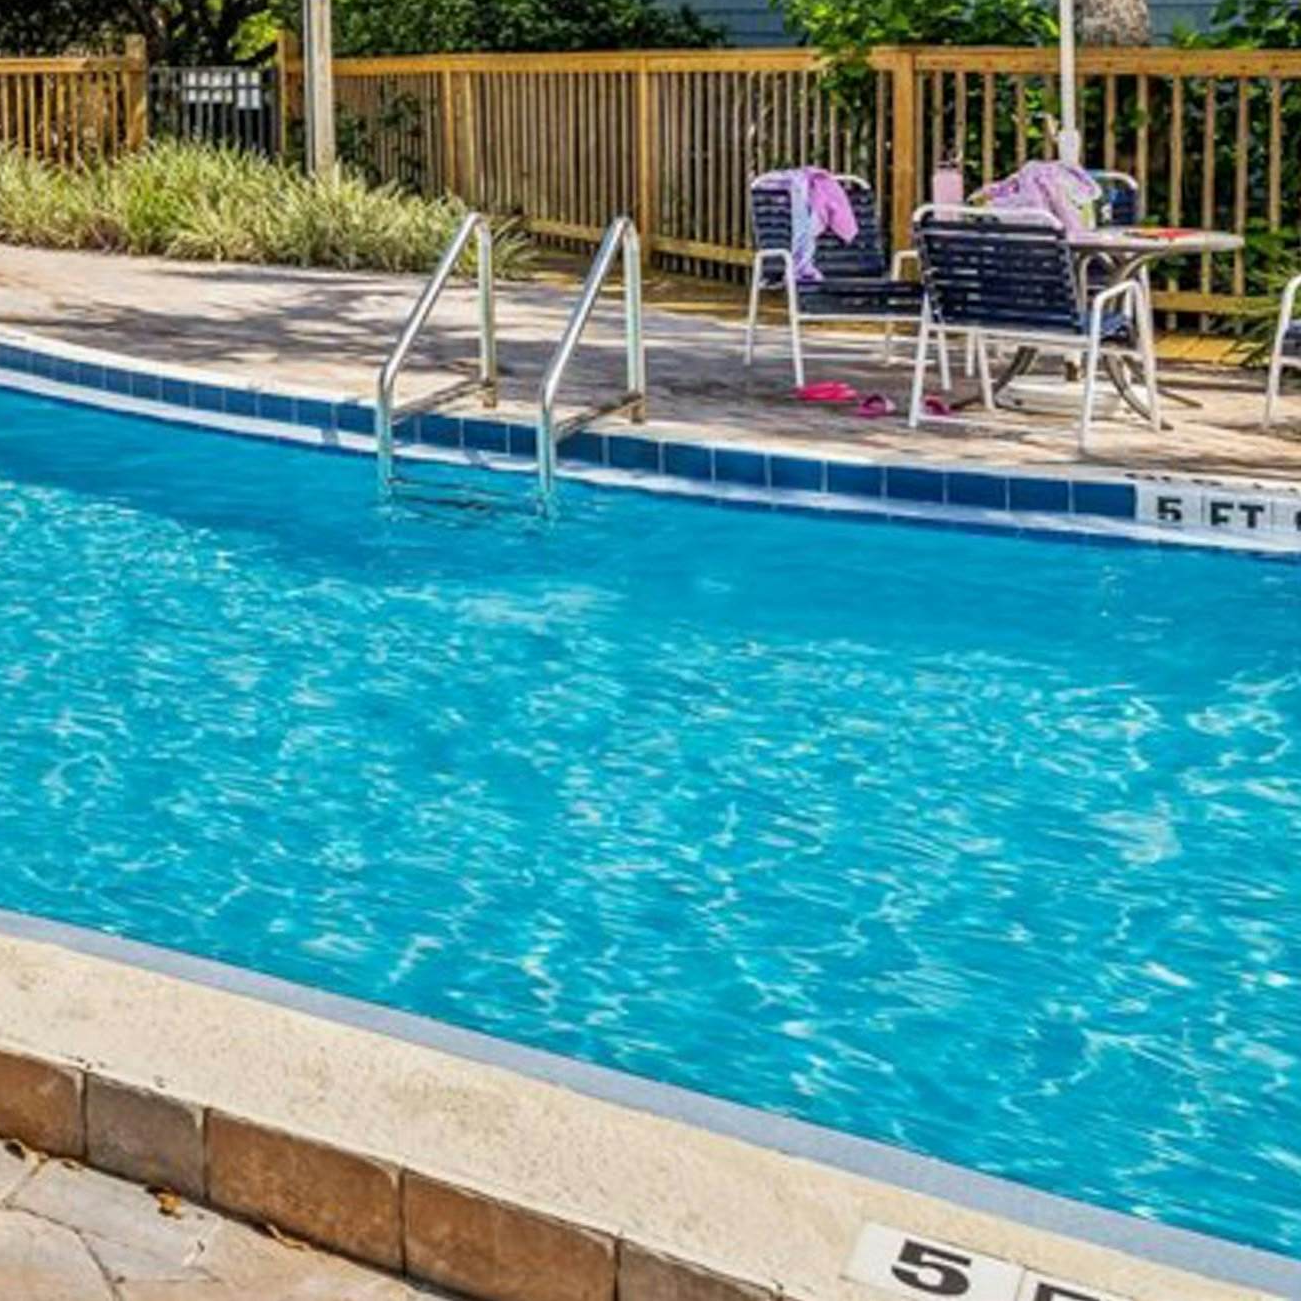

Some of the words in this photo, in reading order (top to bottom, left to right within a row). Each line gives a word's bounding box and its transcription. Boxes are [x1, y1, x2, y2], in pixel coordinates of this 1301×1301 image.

[1156, 495, 1183, 524] 5
[1210, 500, 1265, 530] FT
[890, 1239, 972, 1297] 5
